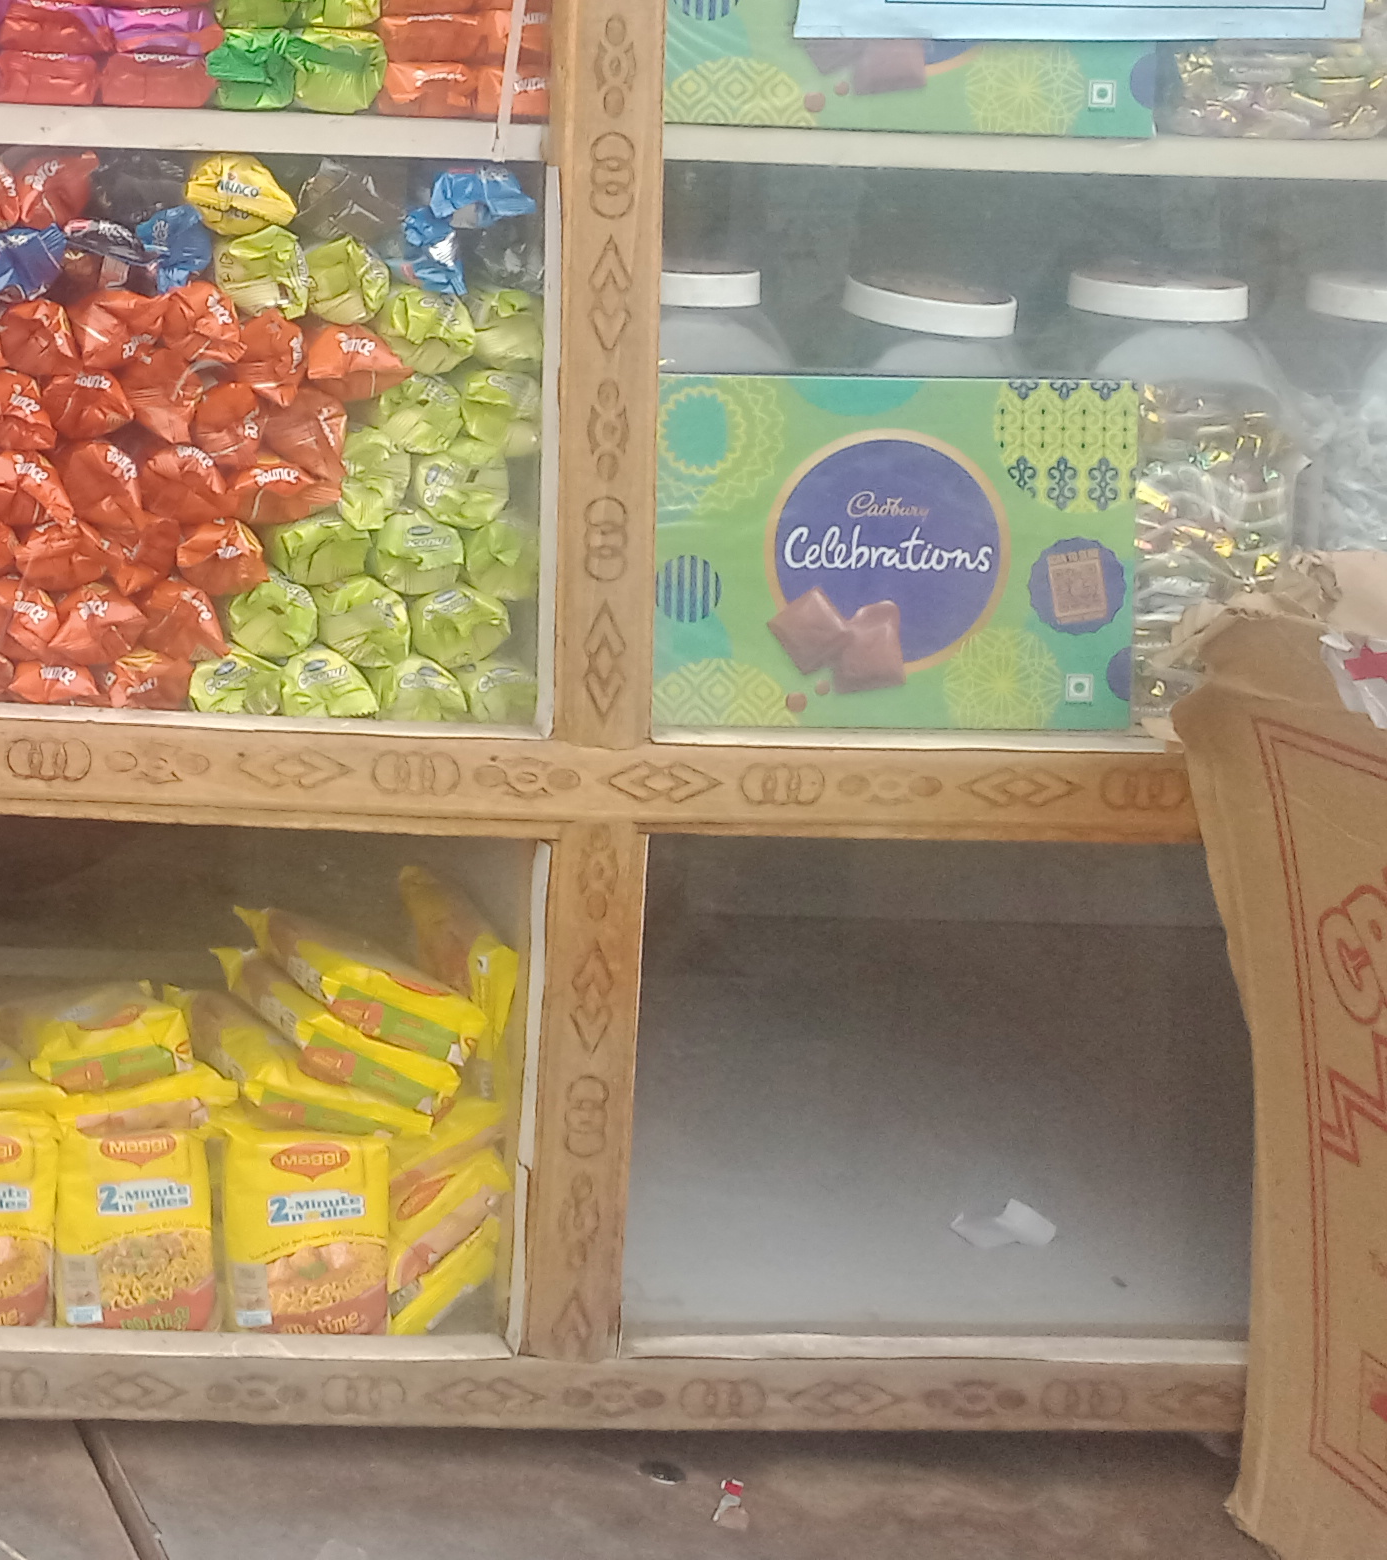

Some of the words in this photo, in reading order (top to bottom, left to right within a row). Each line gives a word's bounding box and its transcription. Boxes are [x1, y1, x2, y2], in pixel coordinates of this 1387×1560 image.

[846, 490, 930, 522] Cadbury
[784, 524, 994, 574] Celebrations
[107, 1137, 169, 1155] Maggi
[280, 1151, 342, 1169] Maggi
